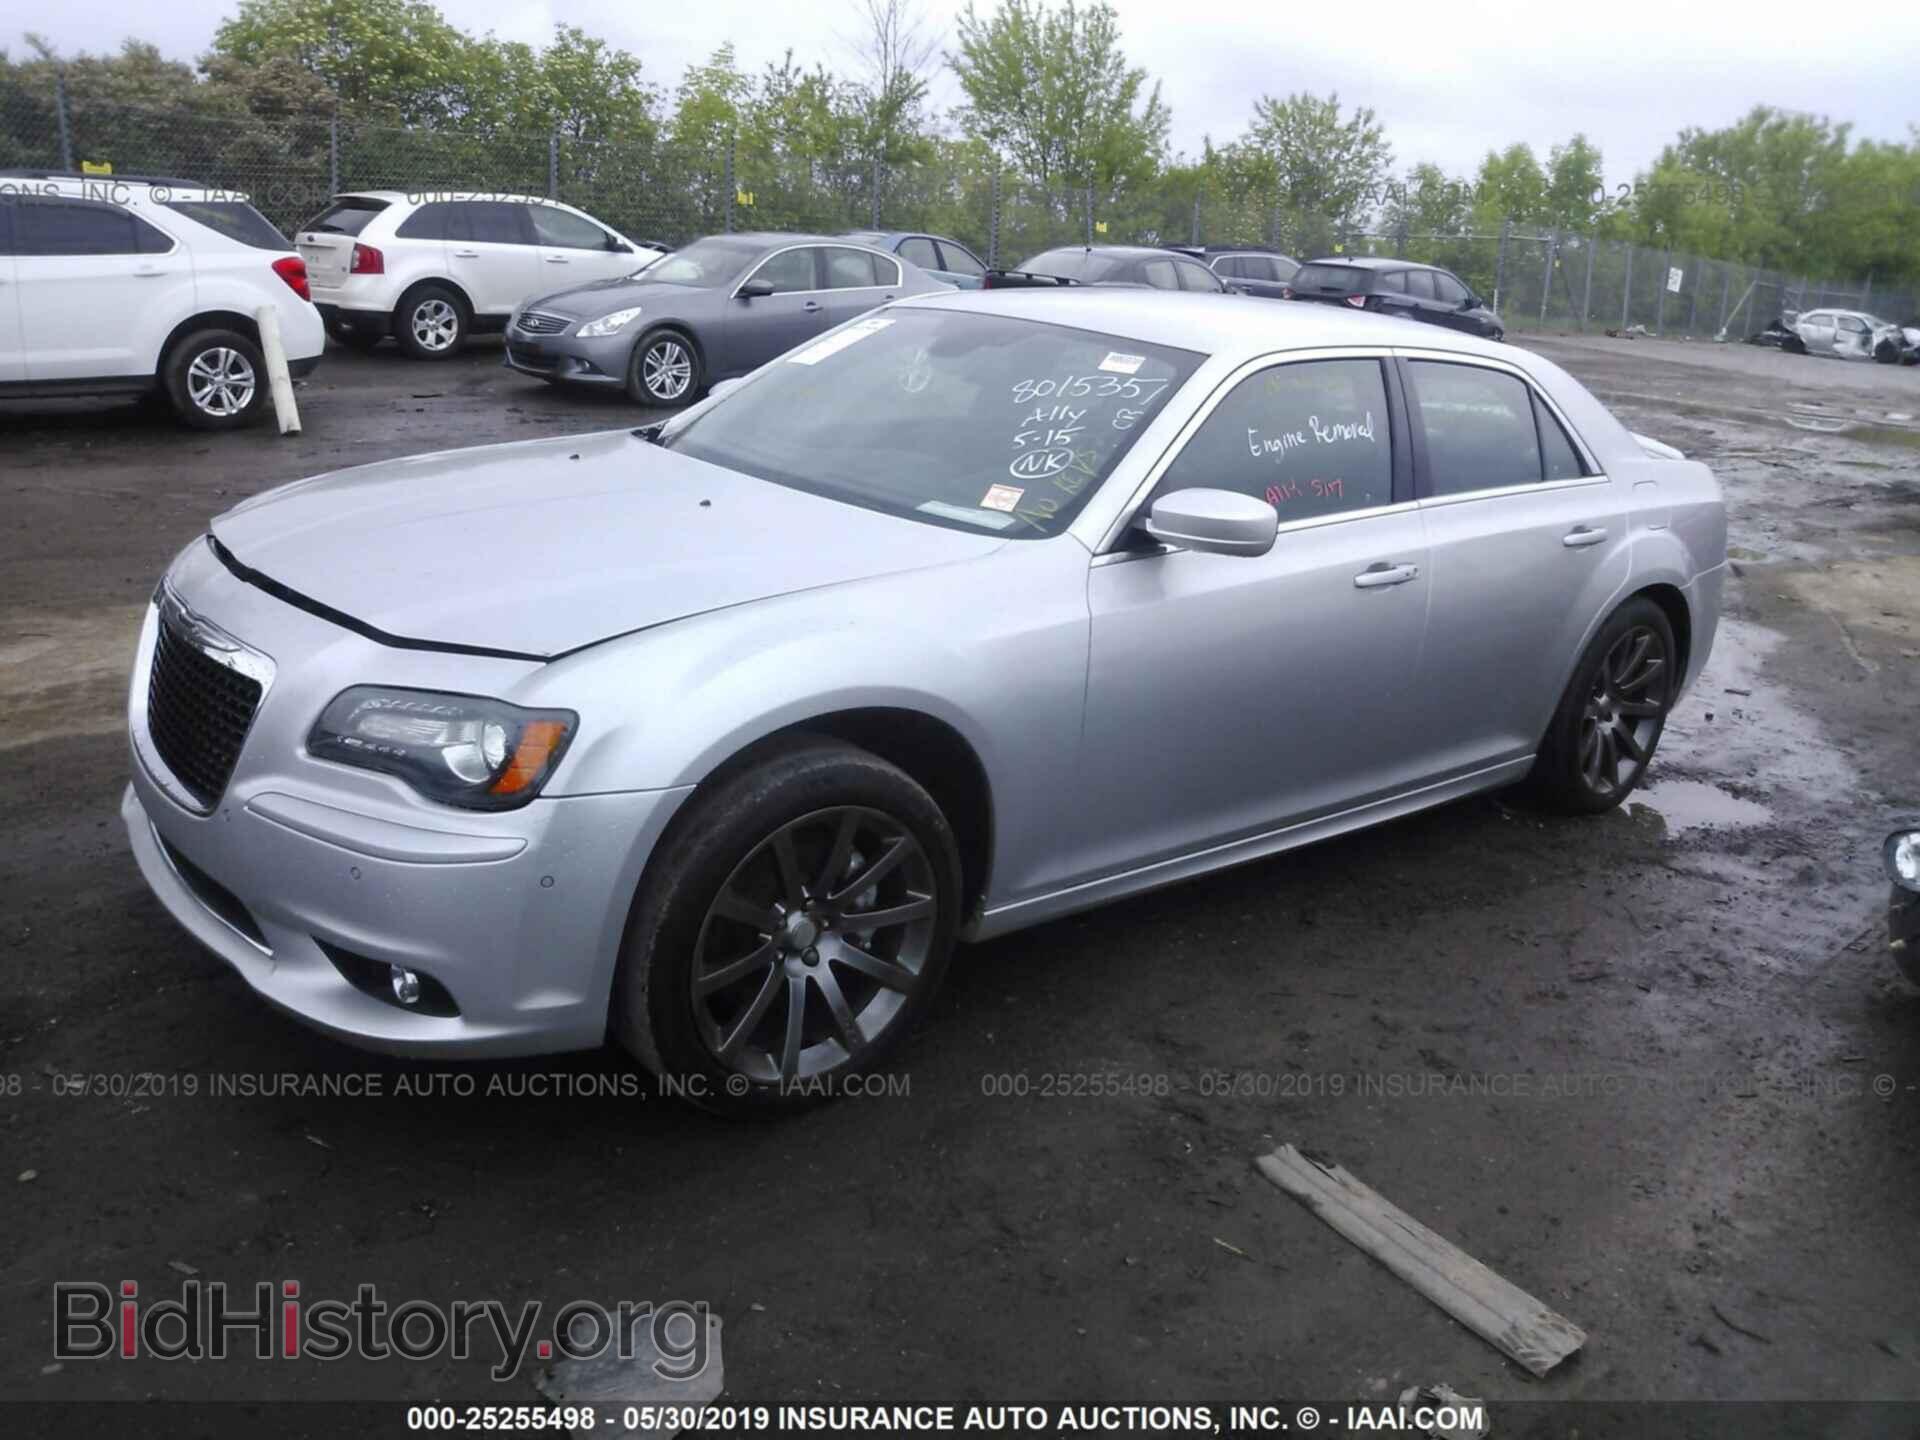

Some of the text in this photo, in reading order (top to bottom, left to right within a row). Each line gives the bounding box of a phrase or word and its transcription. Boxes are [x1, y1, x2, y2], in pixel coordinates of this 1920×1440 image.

[1012, 426, 1086, 448] 5-15
[1247, 411, 1376, 464] Engine Removal
[1017, 453, 1068, 476] NK
